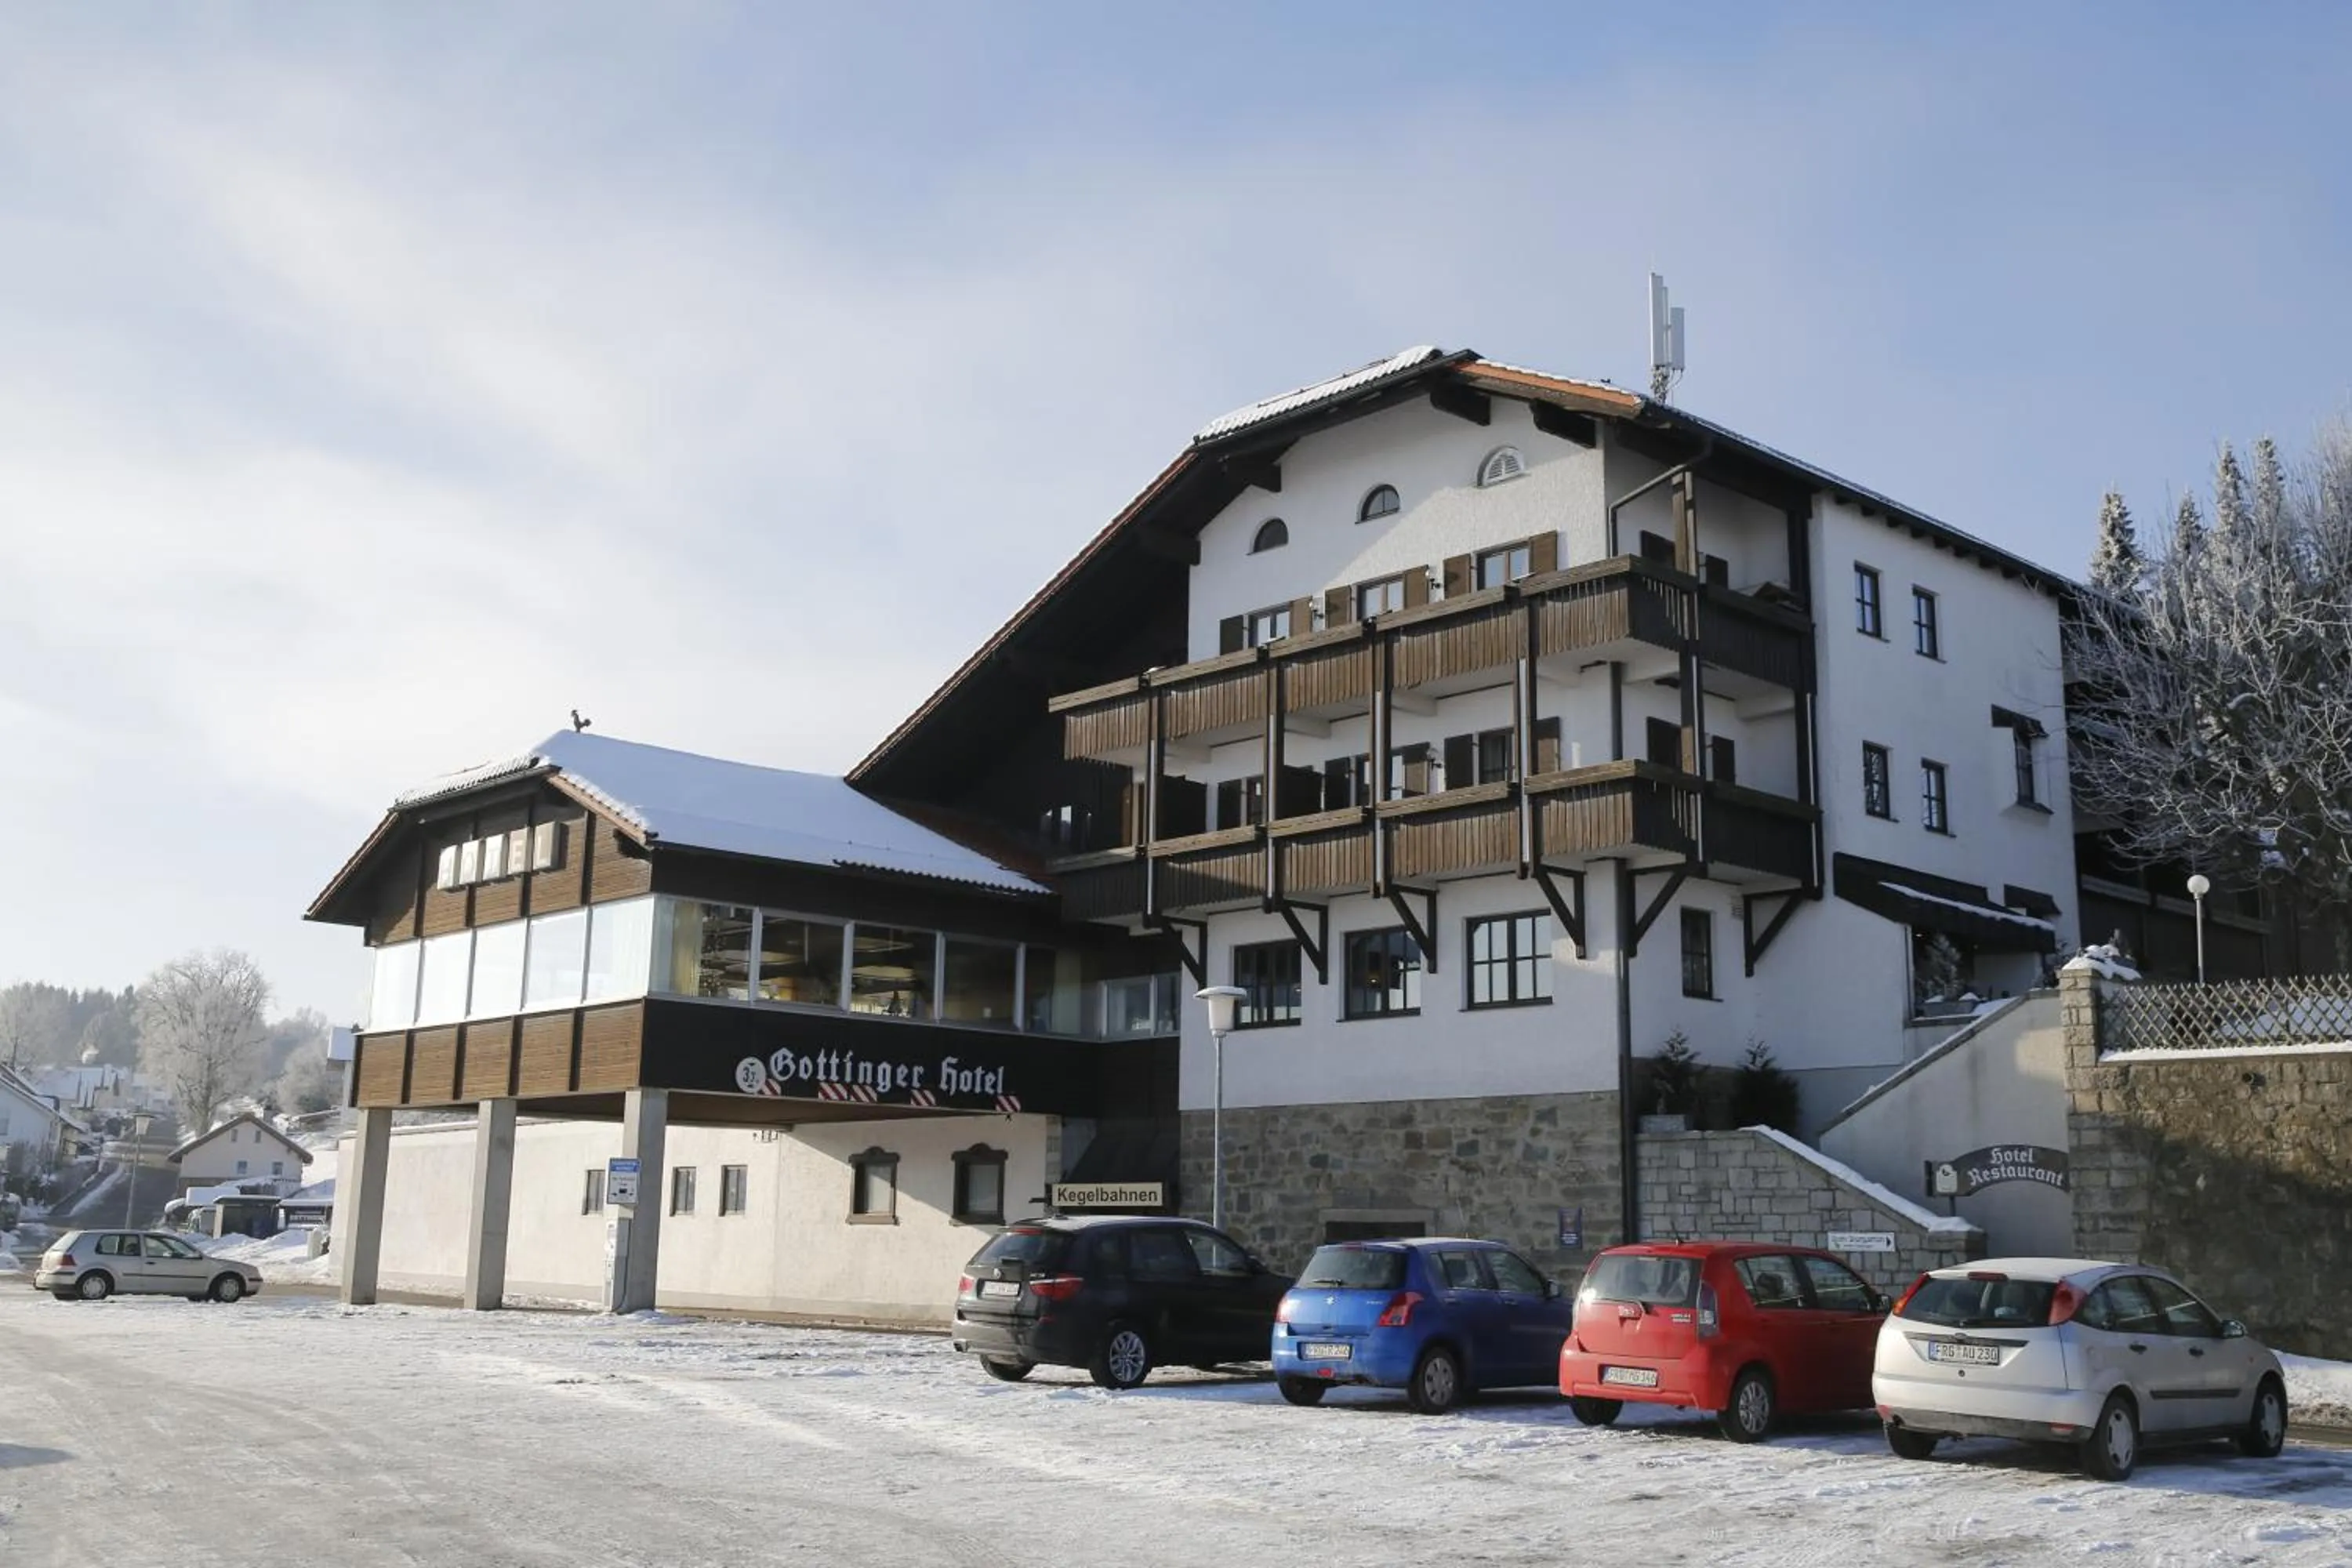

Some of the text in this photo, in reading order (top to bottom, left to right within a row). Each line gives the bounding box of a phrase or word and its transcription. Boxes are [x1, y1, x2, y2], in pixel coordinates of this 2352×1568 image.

[769, 1047, 924, 1092] Gottinger
[940, 1056, 1004, 1095] Hotel
[1990, 1147, 2034, 1163] Hotel
[1967, 1165, 2063, 1185] Restaurant
[1058, 1187, 1158, 1204] Kegelbahnen
